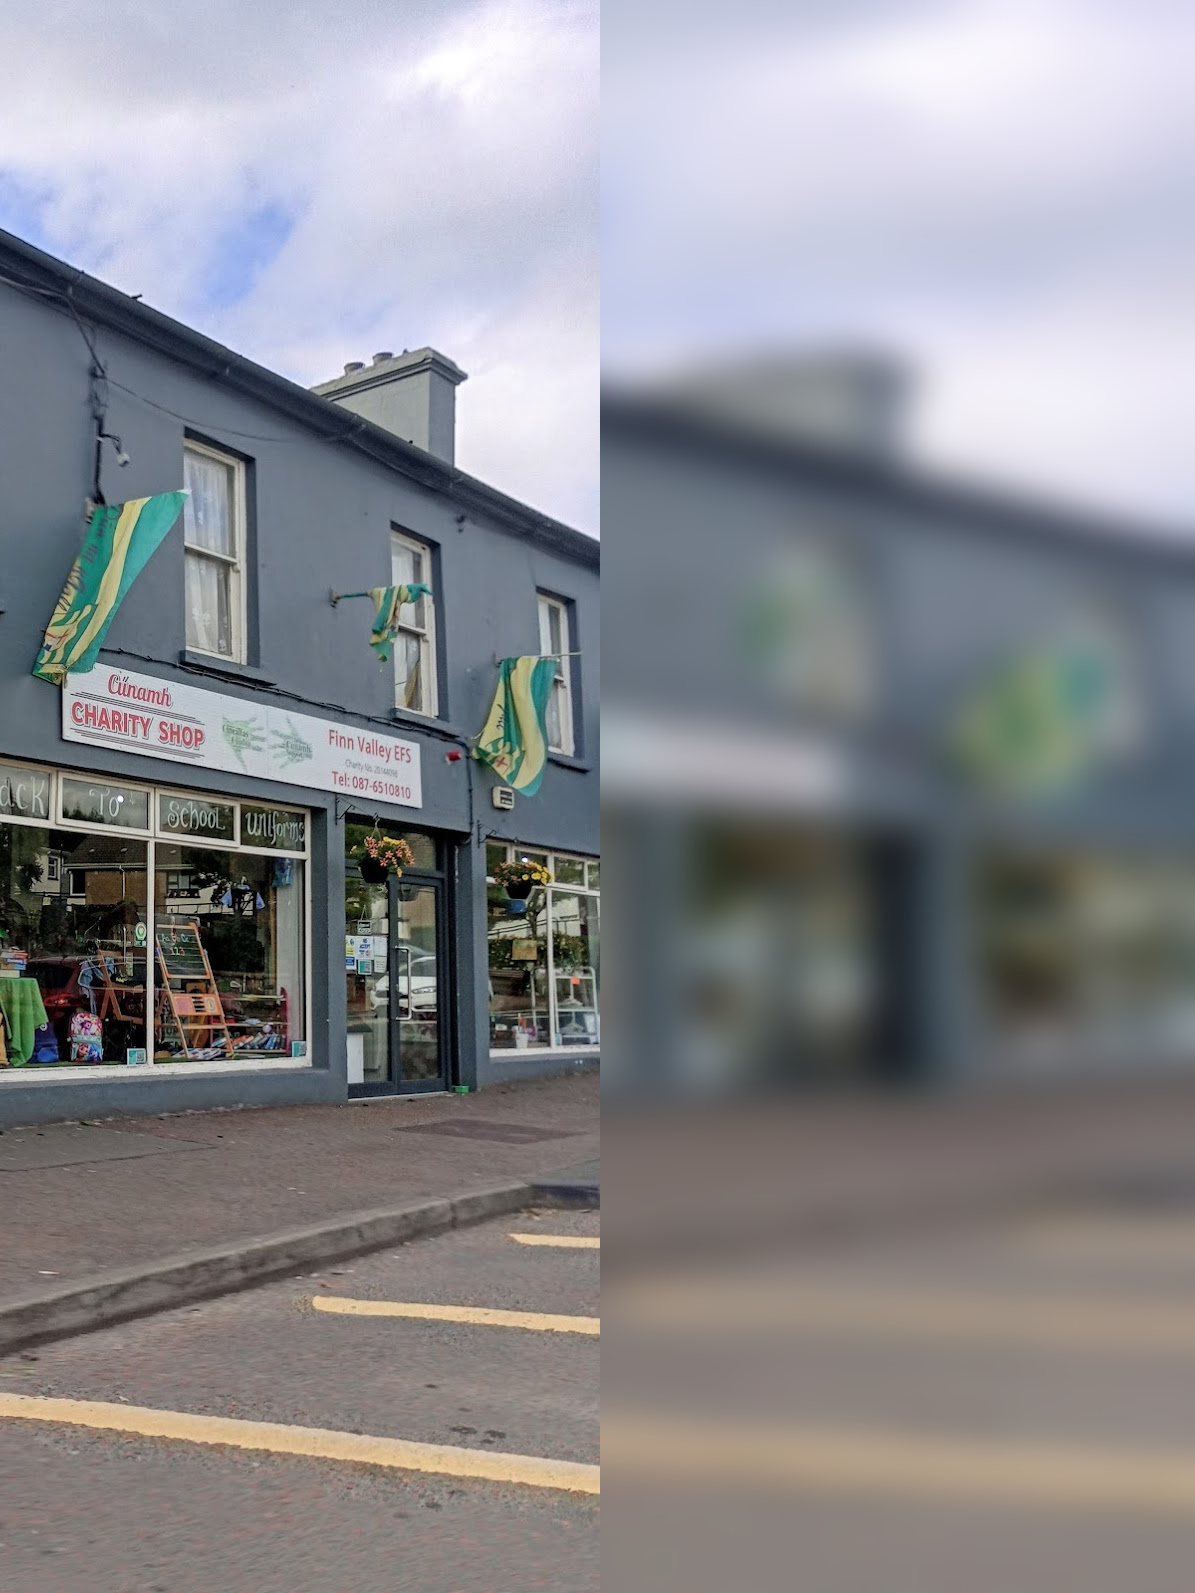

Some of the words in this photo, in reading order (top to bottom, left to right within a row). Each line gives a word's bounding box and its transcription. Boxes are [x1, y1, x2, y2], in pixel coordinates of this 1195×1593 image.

[71, 701, 153, 740] CHARITY
[158, 720, 205, 750] SHOP
[328, 729, 354, 750] Finn
[357, 736, 391, 763] Valley
[394, 746, 412, 763] EFS
[332, 771, 350, 788] Tel:
[352, 775, 411, 799] 087-6510810
